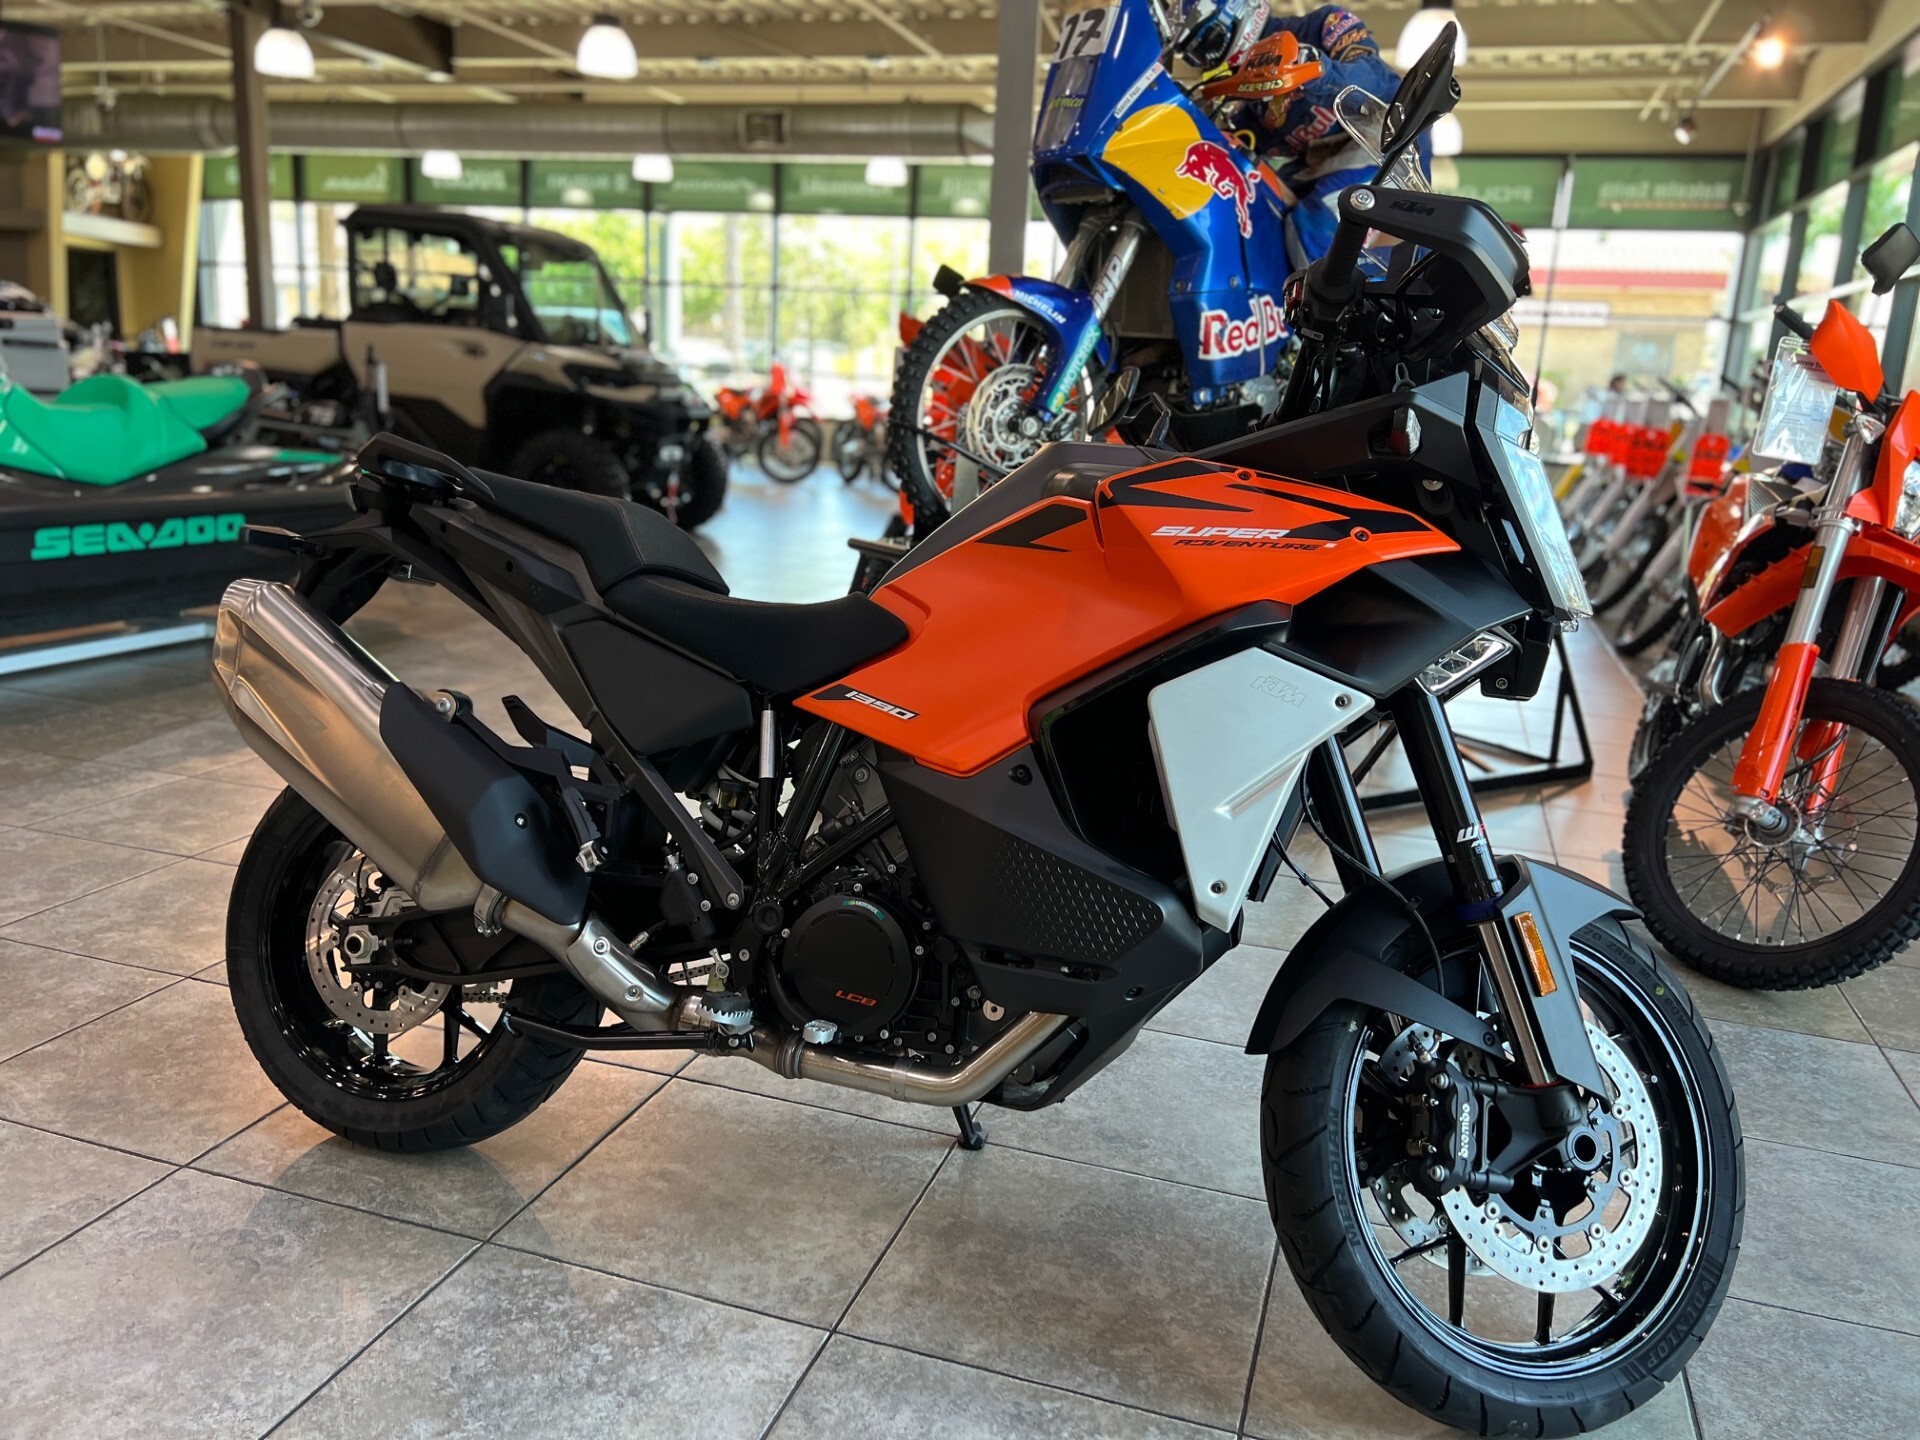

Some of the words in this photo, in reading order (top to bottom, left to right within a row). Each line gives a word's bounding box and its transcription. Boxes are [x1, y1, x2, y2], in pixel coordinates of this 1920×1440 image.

[1055, 8, 1106, 60] 17
[1247, 53, 1283, 69] KTM
[1237, 78, 1285, 93] ACERBIS
[1389, 199, 1435, 217] KTM
[1013, 289, 1067, 325] MICHELIN
[1200, 298, 1262, 359] Red
[1262, 293, 1289, 345] Bu
[1059, 325, 1101, 394] MOTOREX
[1150, 525, 1291, 540] SUPER
[1173, 539, 1321, 551] ADVENTURE
[844, 690, 916, 720] 1390
[1249, 675, 1306, 707] KTM
[1457, 1103, 1471, 1158] brembo
[1328, 1106, 1362, 1248] MERIDIAN
[1647, 1294, 1709, 1369] DUNLOP
